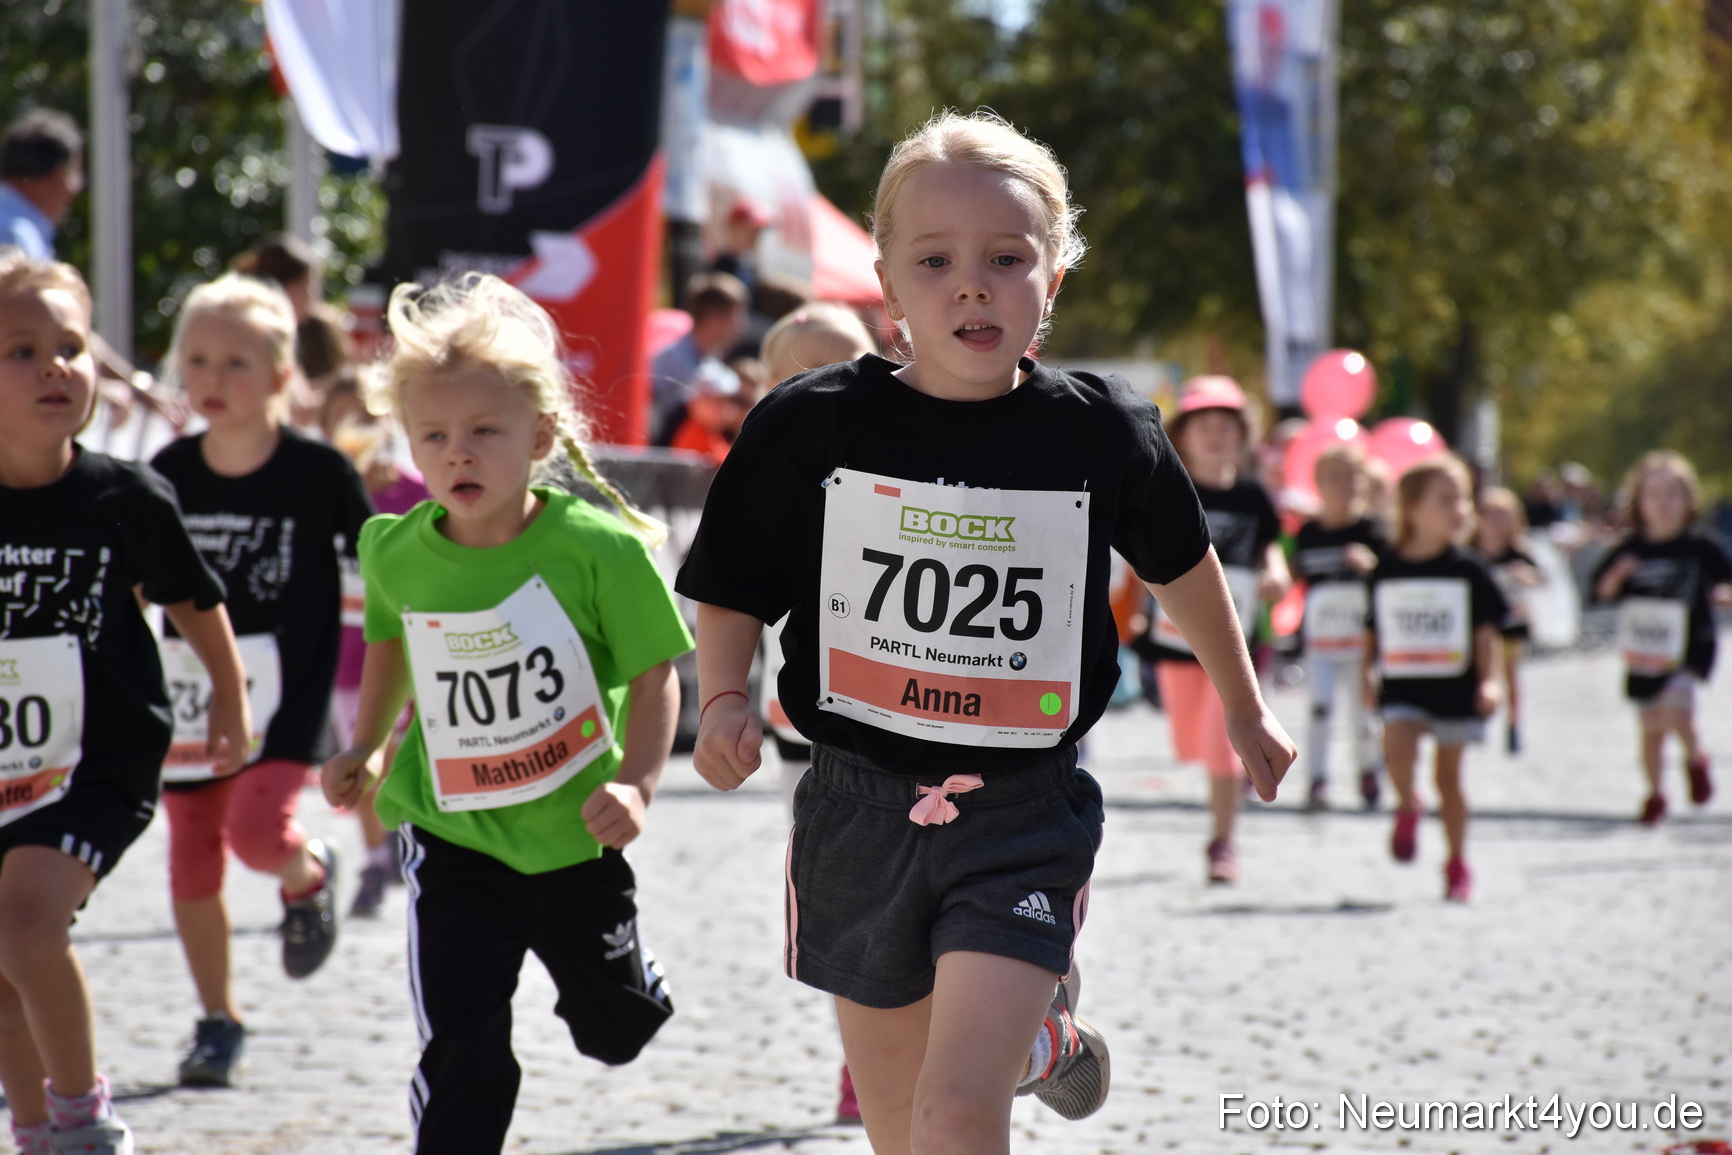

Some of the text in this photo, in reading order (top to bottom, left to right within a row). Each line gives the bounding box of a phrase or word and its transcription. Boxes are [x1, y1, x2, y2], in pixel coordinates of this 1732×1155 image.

[900, 507, 1016, 542] BOCK
[899, 532, 1016, 553] inspired by smart concepts
[831, 598, 845, 614] B1
[862, 547, 1044, 642] 7025
[445, 622, 519, 653] BOCK
[870, 636, 1003, 668] PARTL Neumarkt
[436, 646, 564, 728] 7073
[900, 678, 982, 717] Anna
[459, 719, 553, 750] PARTL Neumarkt
[471, 740, 569, 788] Mathilda
[1013, 907, 1056, 925] adidas
